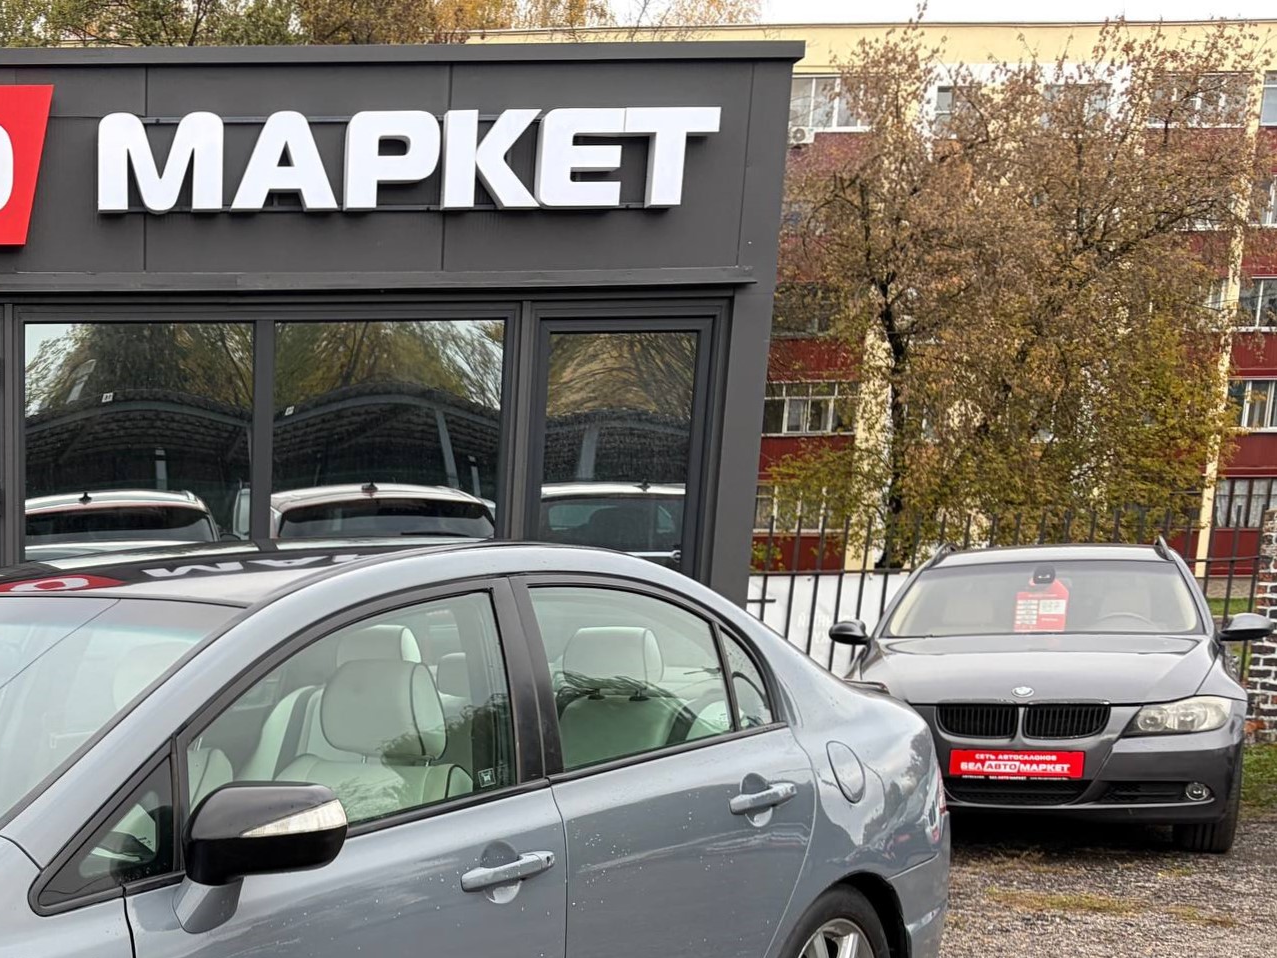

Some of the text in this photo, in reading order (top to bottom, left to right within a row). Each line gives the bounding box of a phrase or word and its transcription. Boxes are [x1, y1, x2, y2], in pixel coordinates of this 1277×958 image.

[97, 106, 722, 214] МАРКЕТ
[960, 762, 1070, 773] БЕЛ АВТО МАРКЕТ
